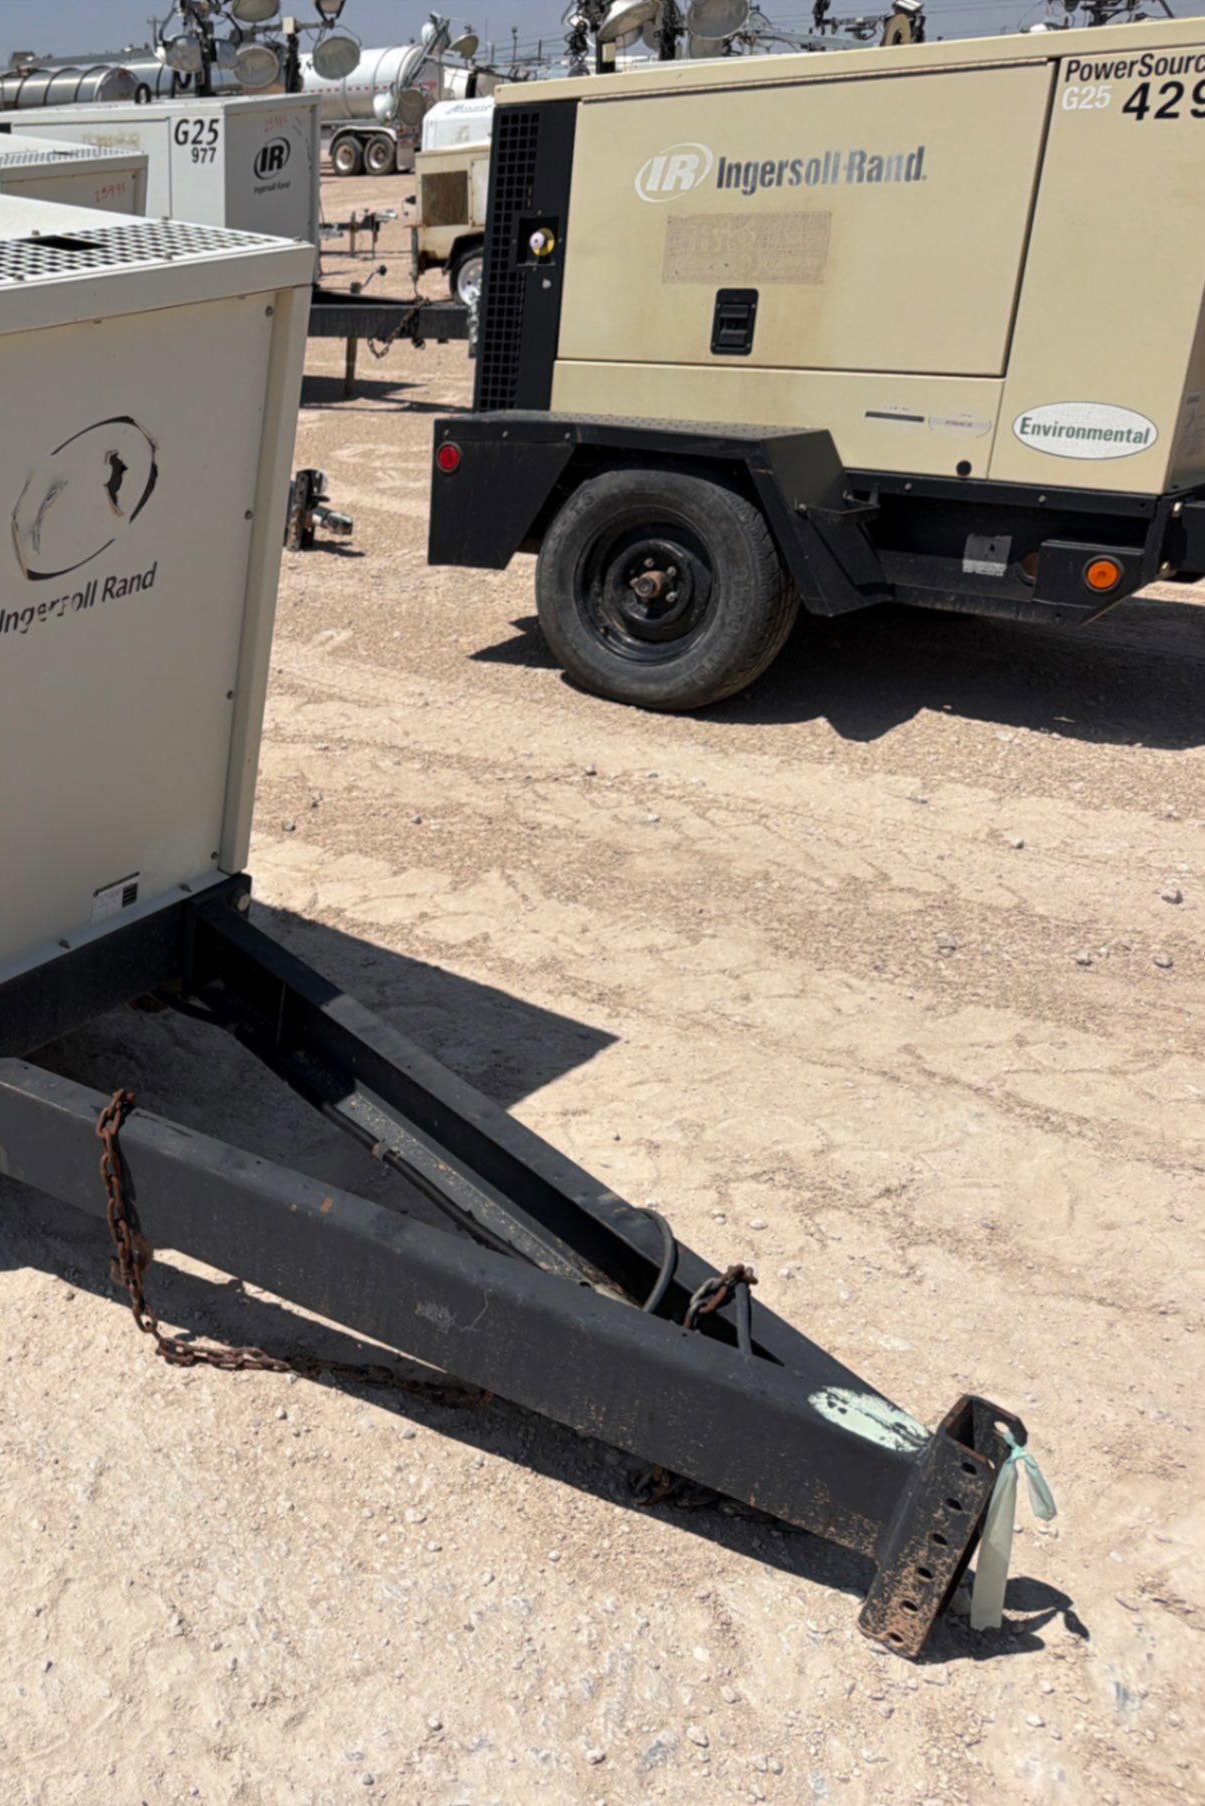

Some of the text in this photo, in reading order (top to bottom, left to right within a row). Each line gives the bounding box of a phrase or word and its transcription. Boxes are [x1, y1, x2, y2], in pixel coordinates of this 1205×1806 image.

[1061, 84, 1113, 111] G25
[174, 118, 220, 146] G25
[191, 147, 217, 164] 977
[260, 144, 284, 173] IR
[645, 153, 701, 192] IR
[1019, 416, 1151, 445] Environmental
[100, 560, 158, 603] Rand
